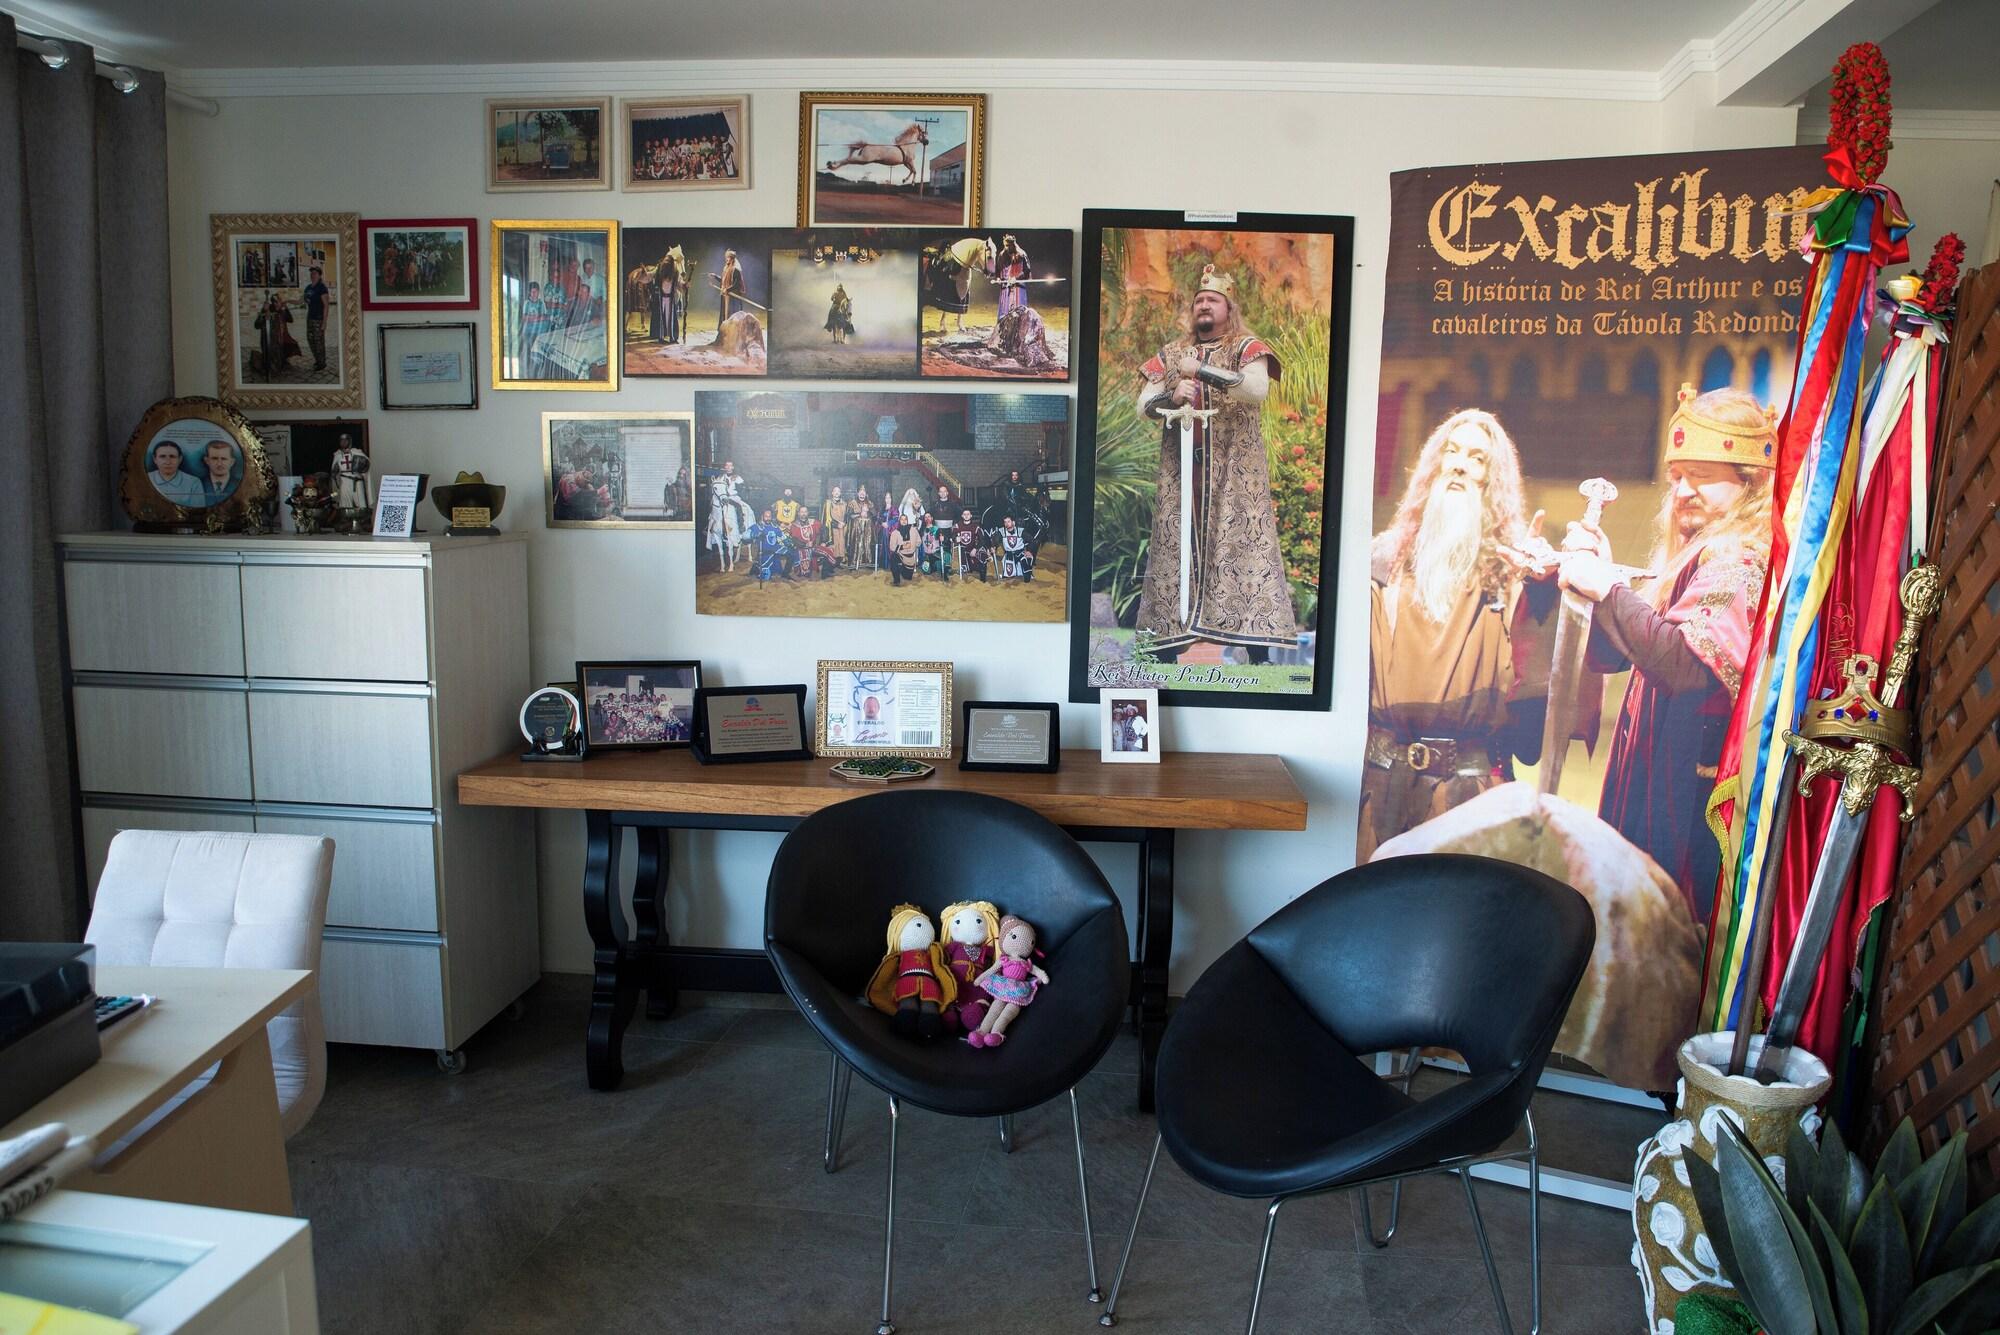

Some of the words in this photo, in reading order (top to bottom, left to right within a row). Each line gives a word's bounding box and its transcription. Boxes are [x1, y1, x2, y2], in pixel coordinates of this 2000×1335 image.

[1433, 278, 1455, 302] A
[1462, 276, 1552, 306] história
[1560, 279, 1587, 301] de
[1594, 277, 1642, 302] Rei
[1651, 276, 1743, 304] Arthur
[1752, 279, 1765, 298] e
[1773, 276, 1805, 297] os
[1432, 312, 1549, 336] cavaleiros
[1555, 313, 1584, 336] da
[1592, 309, 1683, 336] Távola
[1092, 663, 1121, 683] Rei
[1127, 661, 1171, 684] Huter
